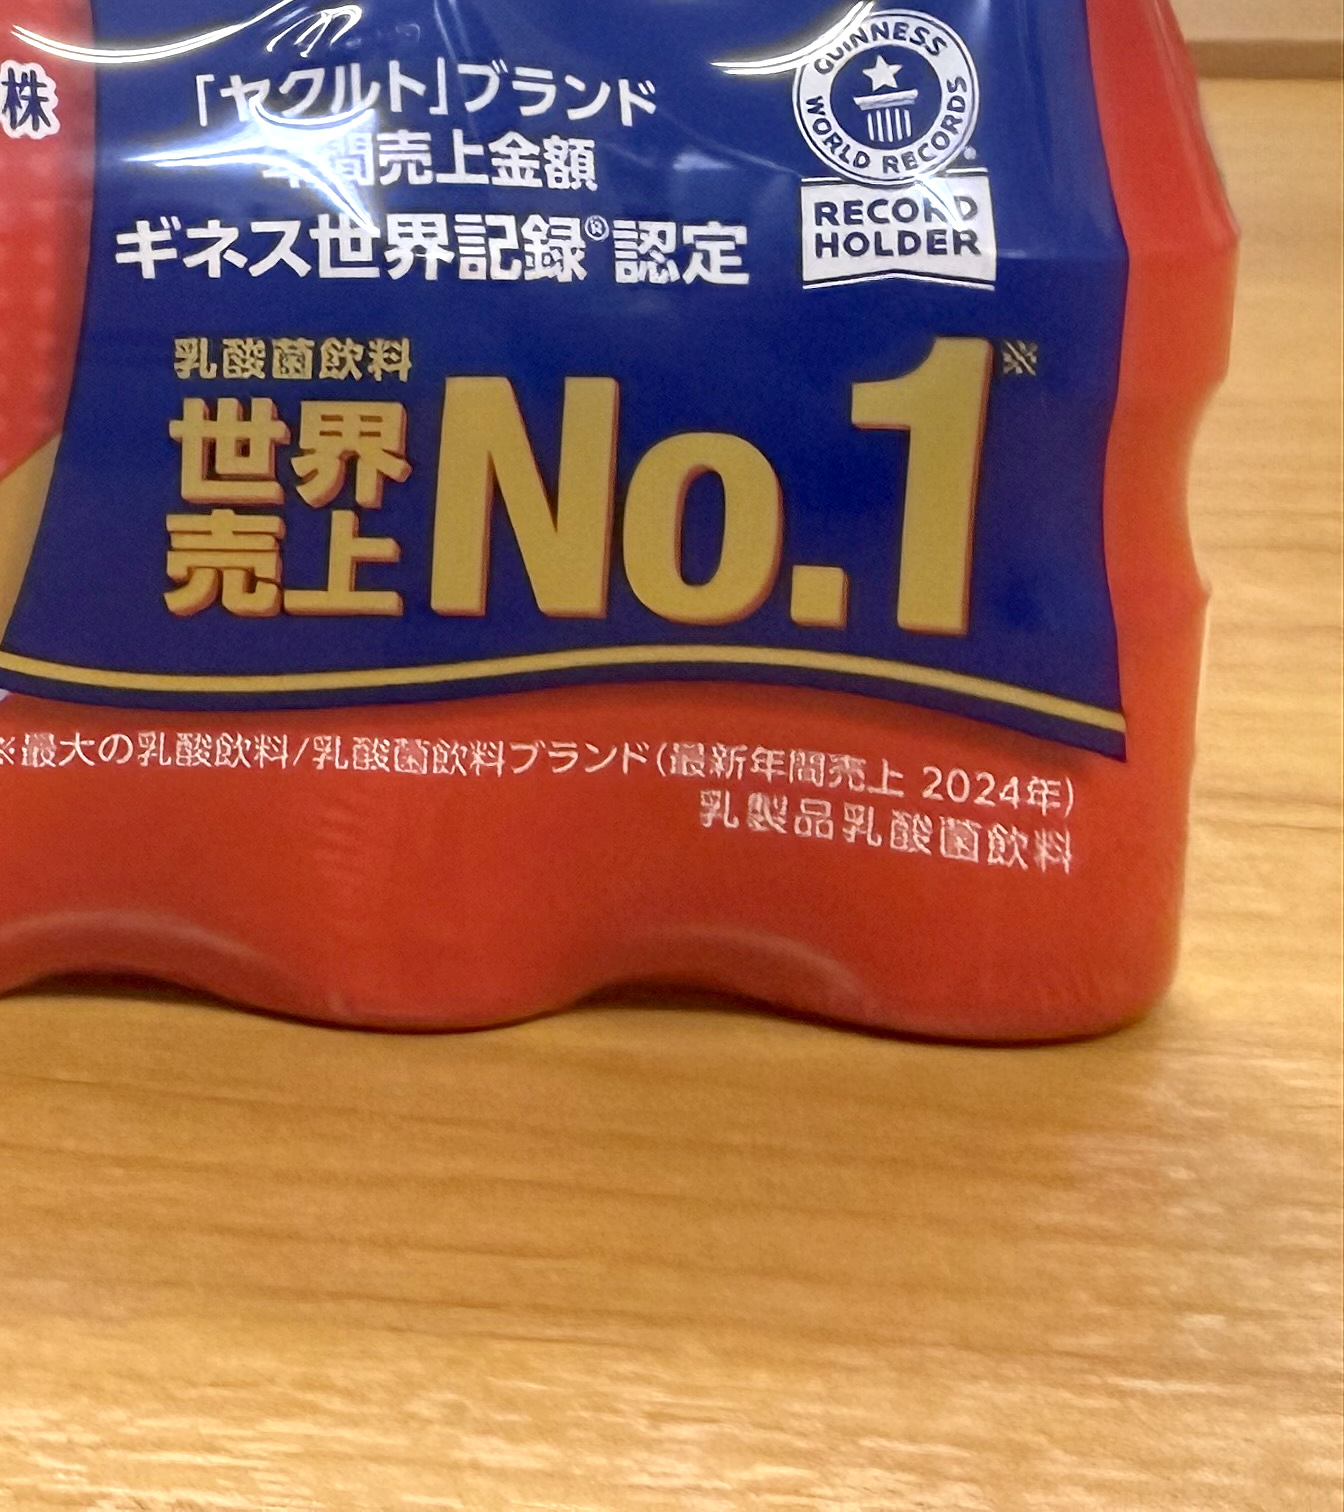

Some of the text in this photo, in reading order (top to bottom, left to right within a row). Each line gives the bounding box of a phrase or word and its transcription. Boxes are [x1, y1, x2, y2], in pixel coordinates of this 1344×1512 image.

[814, 21, 947, 75] GUINNESS
[806, 75, 967, 174] WORLD RECORDS
[815, 229, 982, 259] HOLDER
[173, 336, 413, 382] 乳酸菌飲料
[168, 396, 412, 510] 世界
[431, 336, 995, 635] No.1
[163, 507, 405, 618] 売上
[699, 789, 1072, 874] 乳製品乳酸菌飲料
